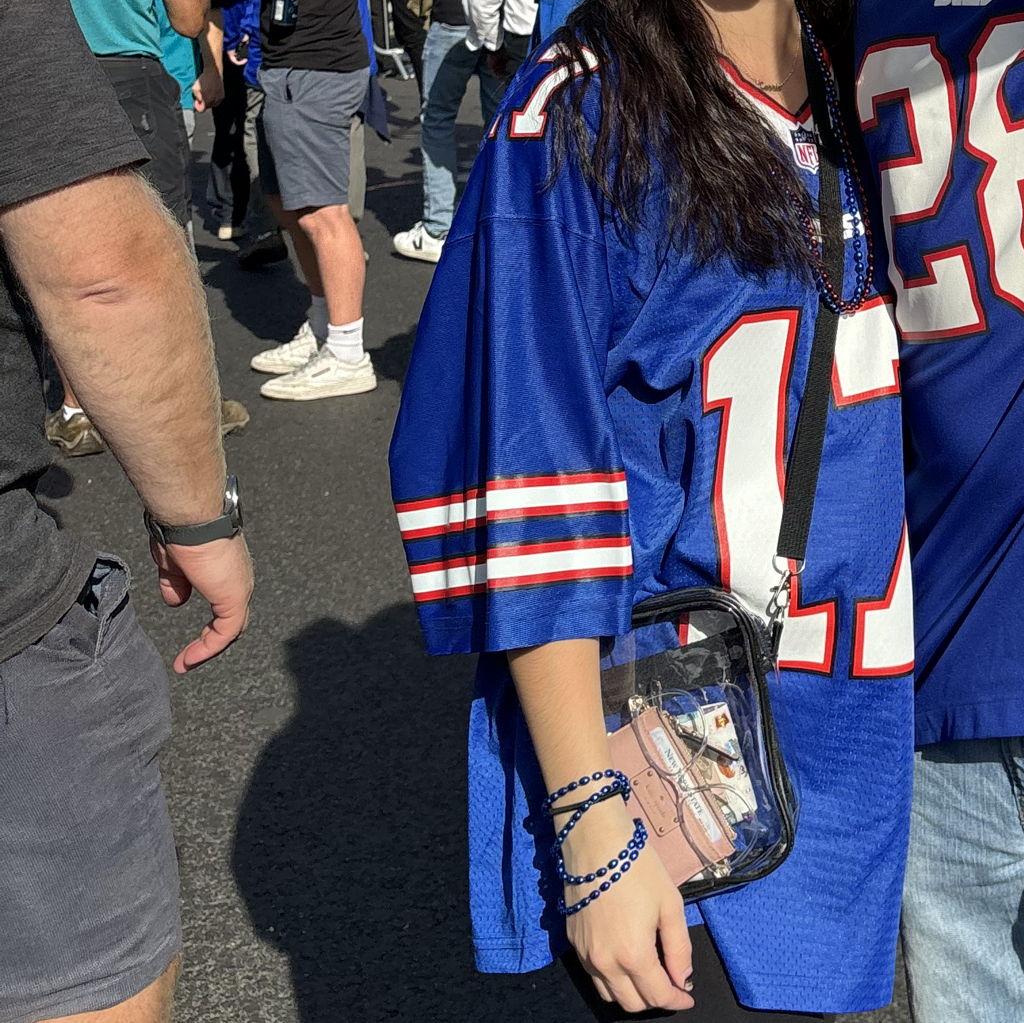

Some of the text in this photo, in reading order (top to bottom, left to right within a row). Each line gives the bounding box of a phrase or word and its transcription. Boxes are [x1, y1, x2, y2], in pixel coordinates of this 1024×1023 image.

[488, 43, 600, 137] 7
[797, 144, 819, 166] NFL
[701, 295, 915, 674] 17
